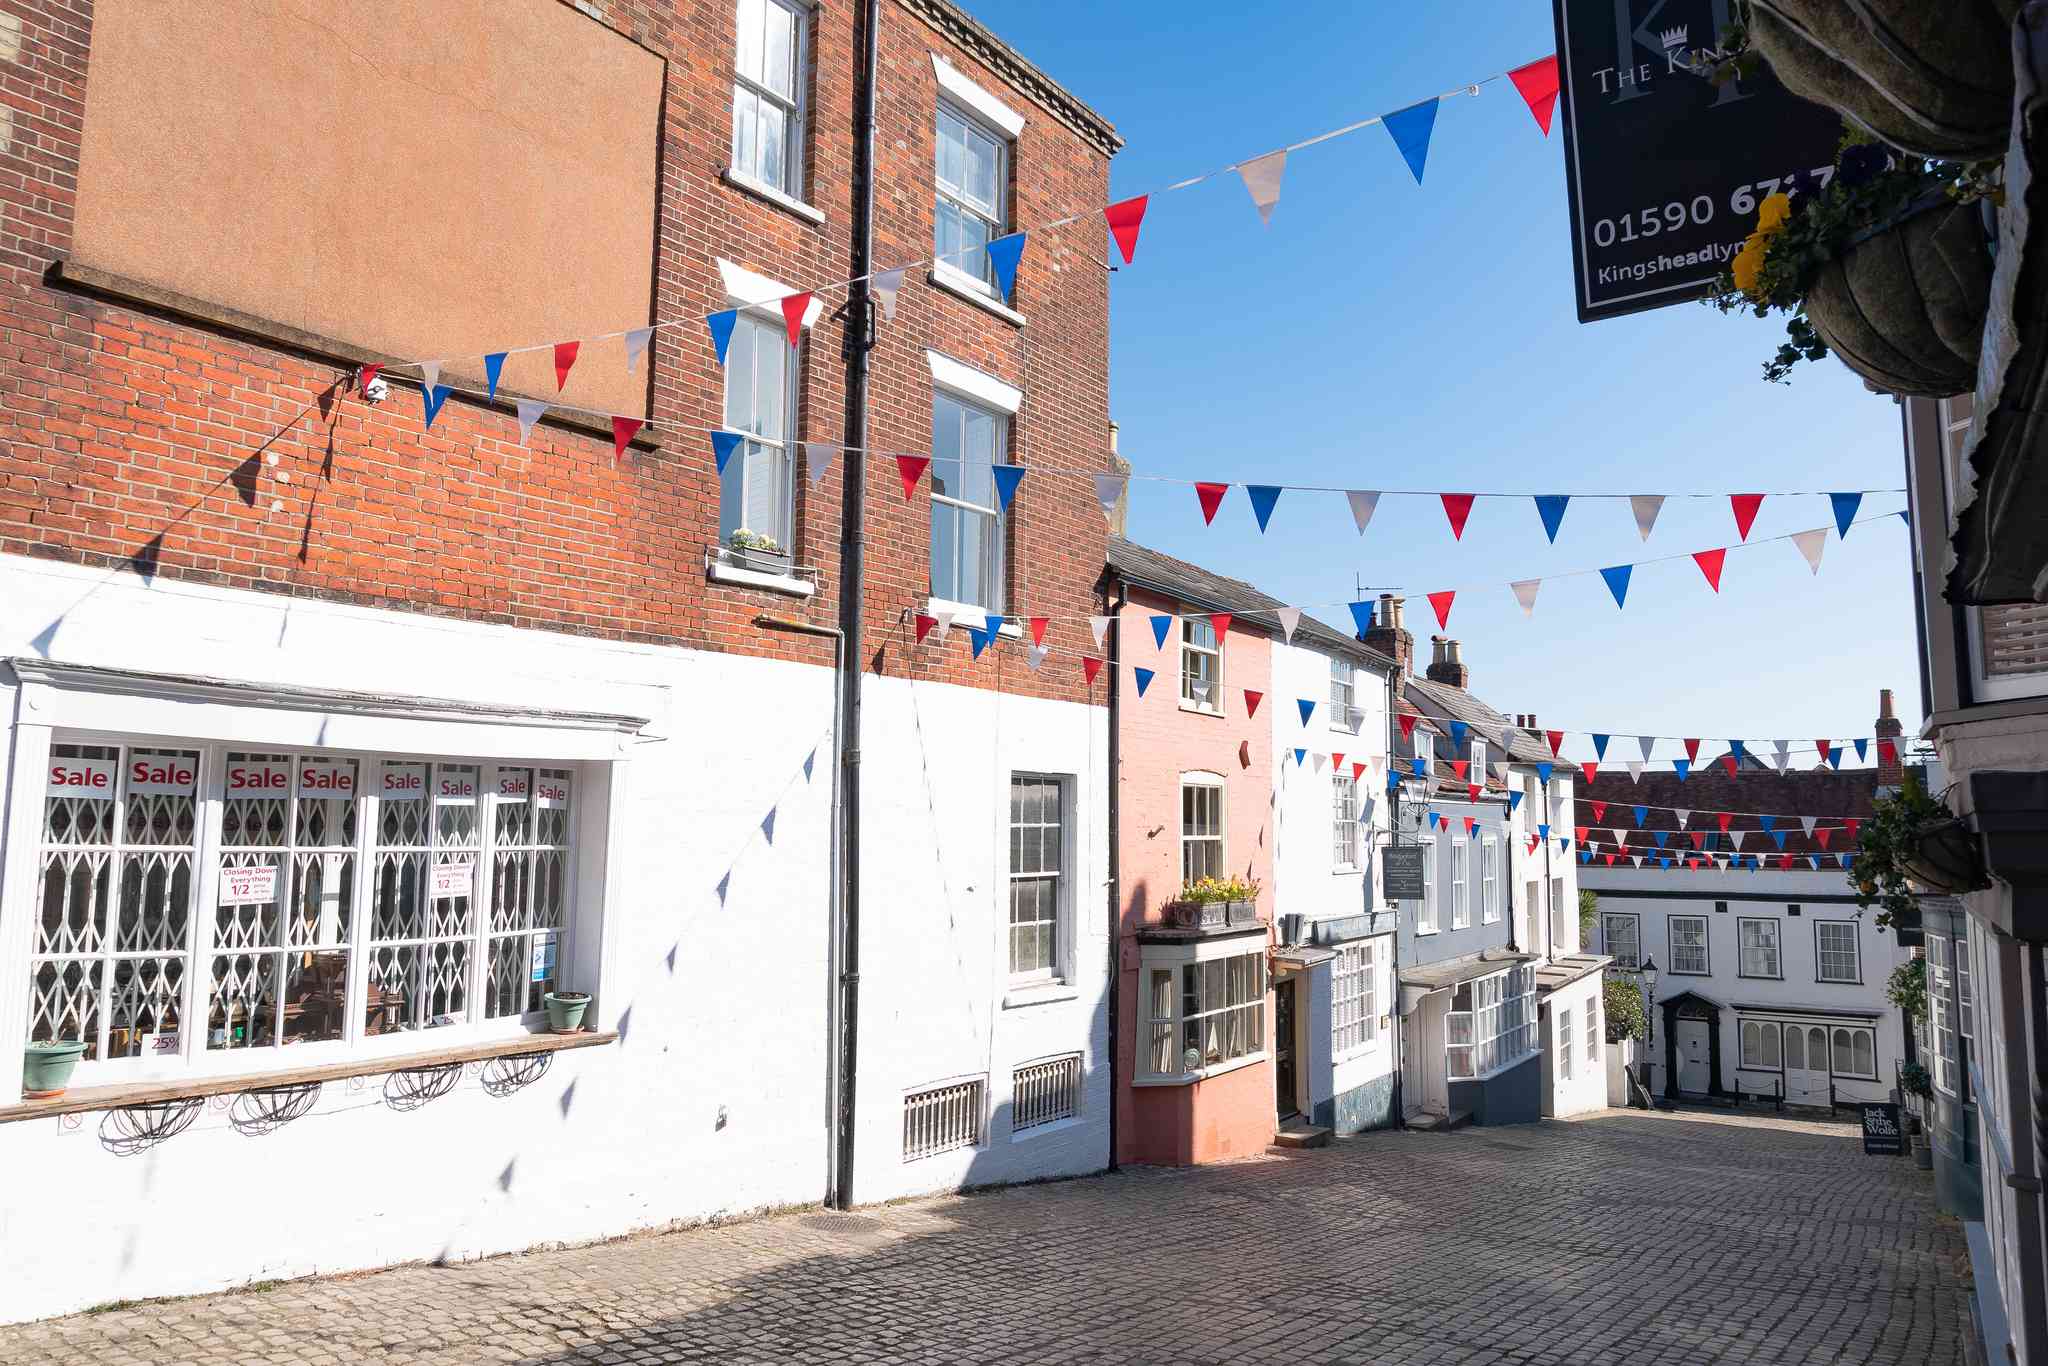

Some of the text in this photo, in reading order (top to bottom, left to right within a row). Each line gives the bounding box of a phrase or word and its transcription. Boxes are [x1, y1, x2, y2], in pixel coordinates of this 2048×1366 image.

[1594, 195, 1714, 247] 01590
[51, 767, 108, 787] Sale
[133, 762, 193, 785] Sale
[230, 767, 287, 788] Sale
[302, 769, 351, 789] Sale
[384, 774, 420, 790] Sale
[441, 780, 472, 796] Sale
[500, 778, 525, 794] Sale
[537, 784, 565, 801] Sale
[231, 884, 250, 896] 1/2
